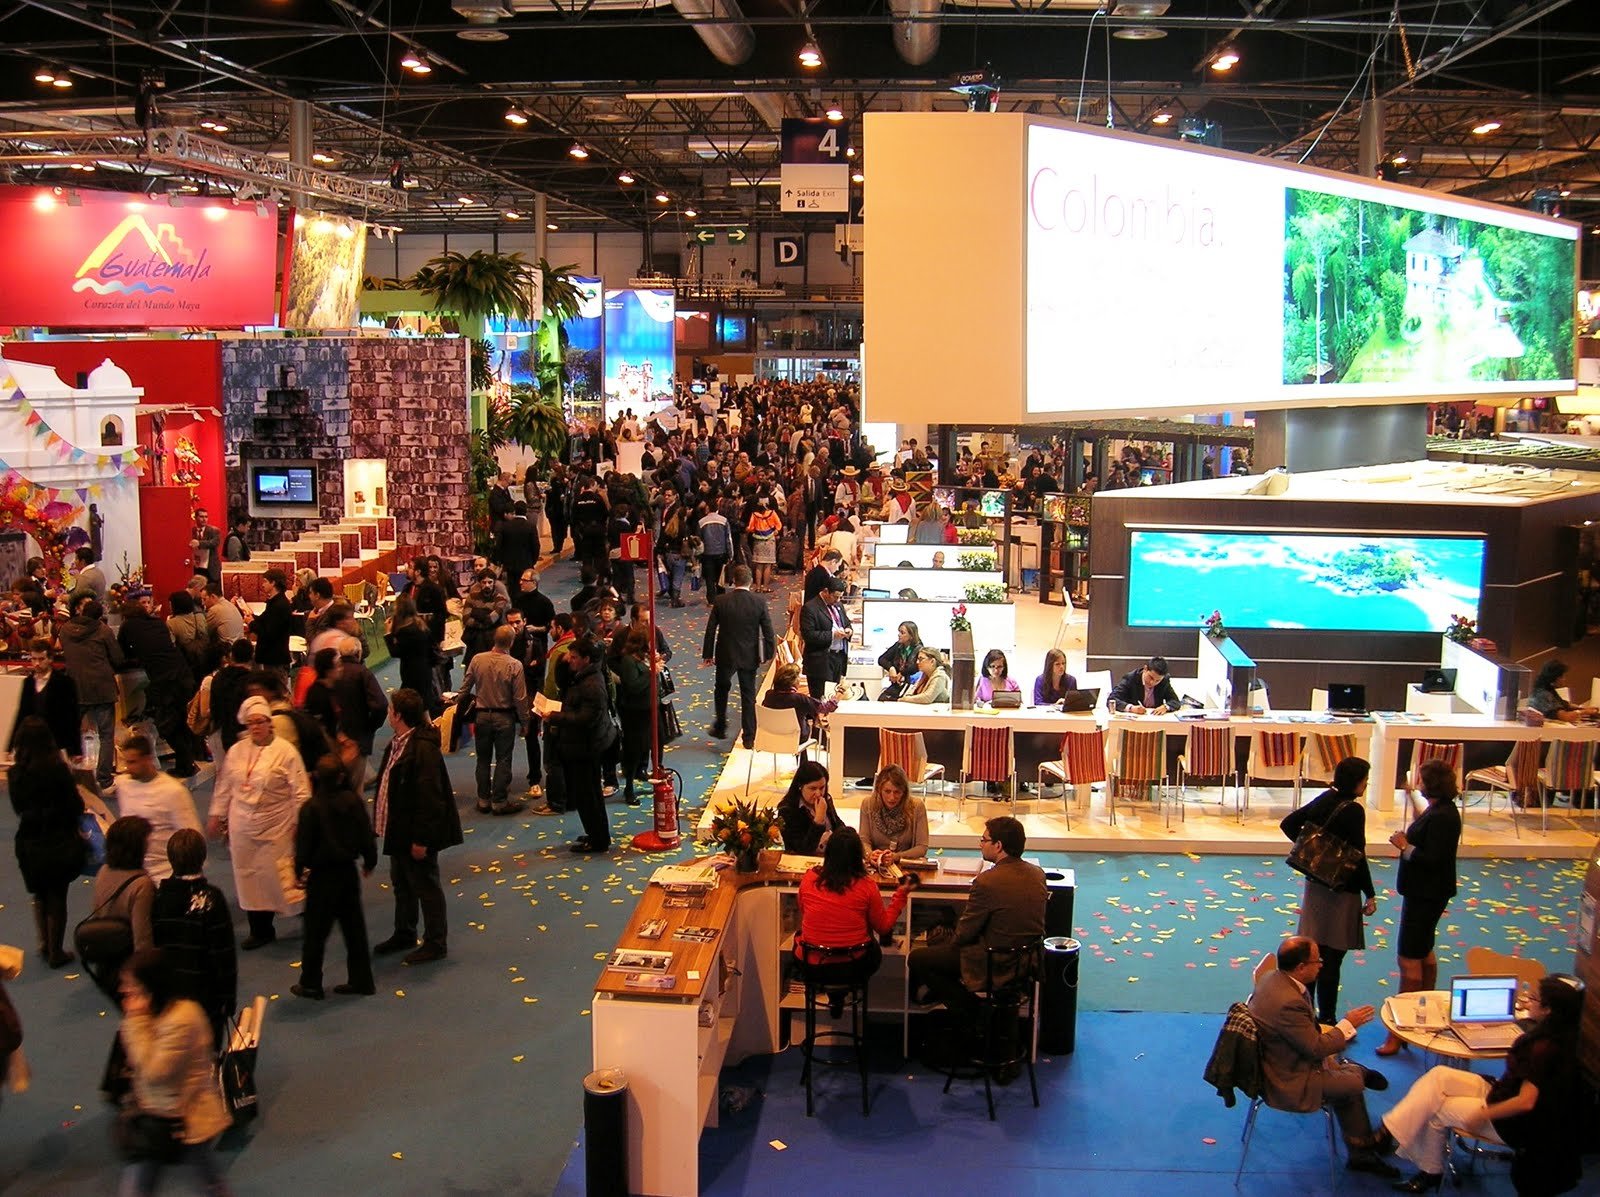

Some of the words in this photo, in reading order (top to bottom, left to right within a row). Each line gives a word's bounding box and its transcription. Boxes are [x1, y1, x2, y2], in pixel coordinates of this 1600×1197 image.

[818, 128, 840, 158] 4
[99, 248, 212, 282] Guatemala
[779, 241, 798, 263] D
[126, 300, 140, 310] del
[143, 300, 175, 310] Mundo
[178, 300, 201, 312] Maya
